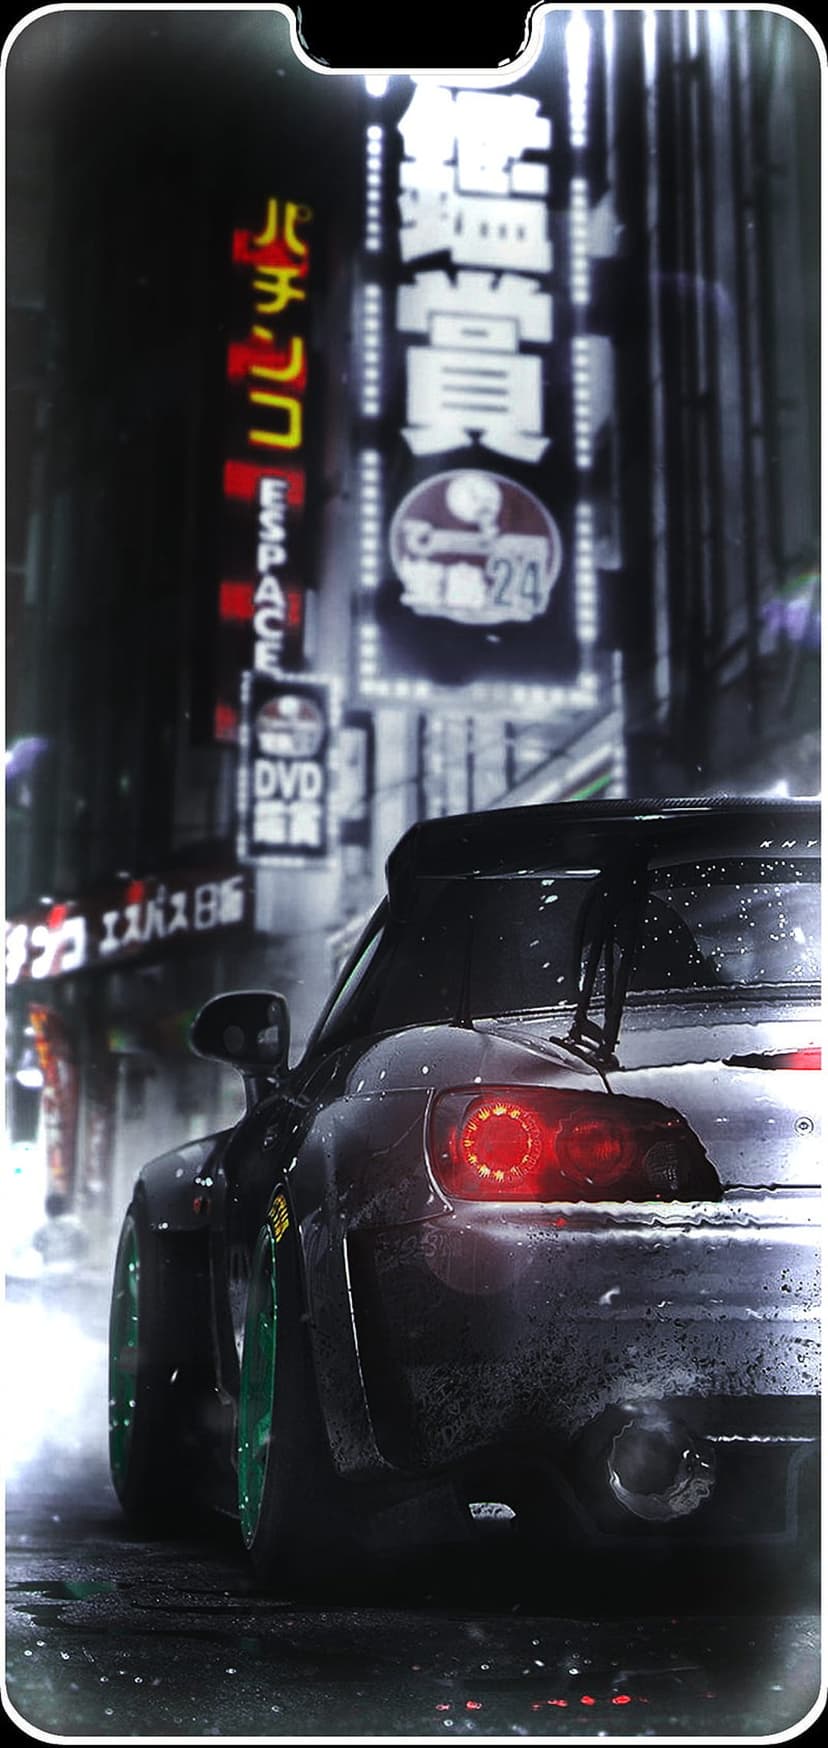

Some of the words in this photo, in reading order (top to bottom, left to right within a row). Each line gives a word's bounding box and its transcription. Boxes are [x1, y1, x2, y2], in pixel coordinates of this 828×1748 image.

[249, 198, 312, 449] パチンコ
[254, 478, 288, 678] ESPACE
[254, 759, 322, 799] DVD
